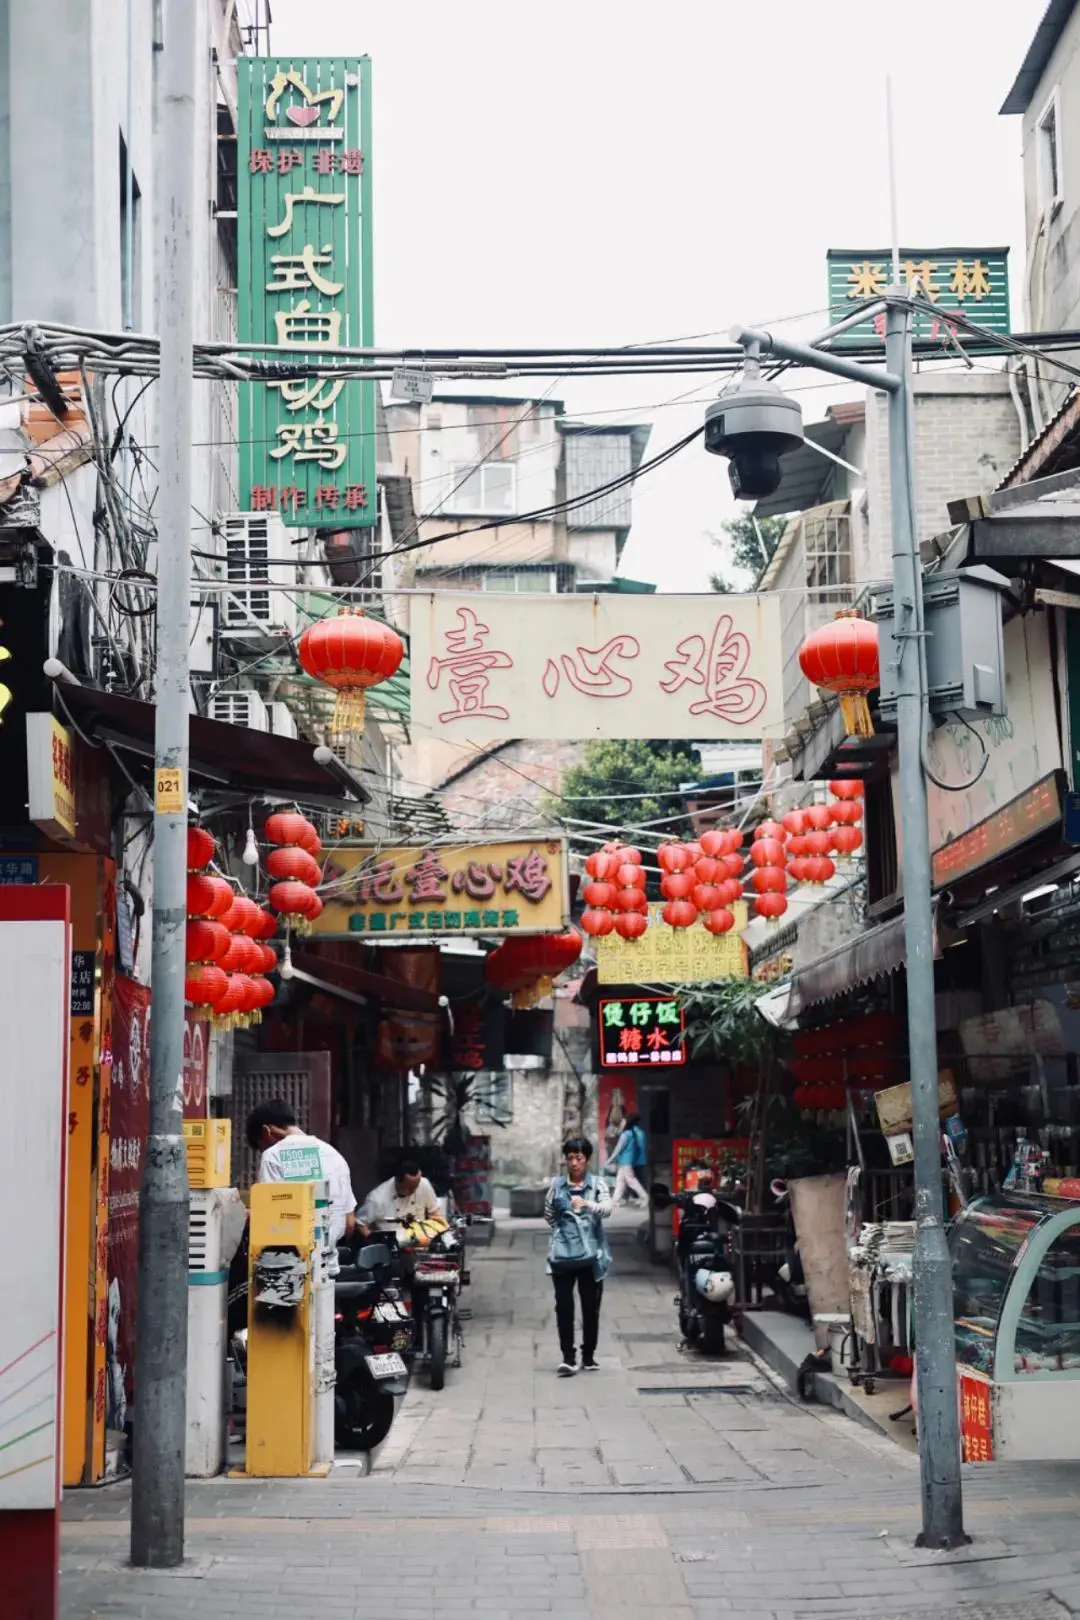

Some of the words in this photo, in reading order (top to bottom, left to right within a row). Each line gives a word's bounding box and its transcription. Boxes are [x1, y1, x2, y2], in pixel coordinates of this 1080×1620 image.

[847, 259, 991, 302] 米其林
[266, 186, 347, 469] 广式白切鸡
[252, 485, 306, 511] 制作
[315, 484, 368, 511] 传承
[427, 607, 767, 725] 壹心鸡
[157, 780, 179, 792] 021
[603, 1002, 680, 1027] 煲仔饭
[618, 1027, 669, 1050] 糖水
